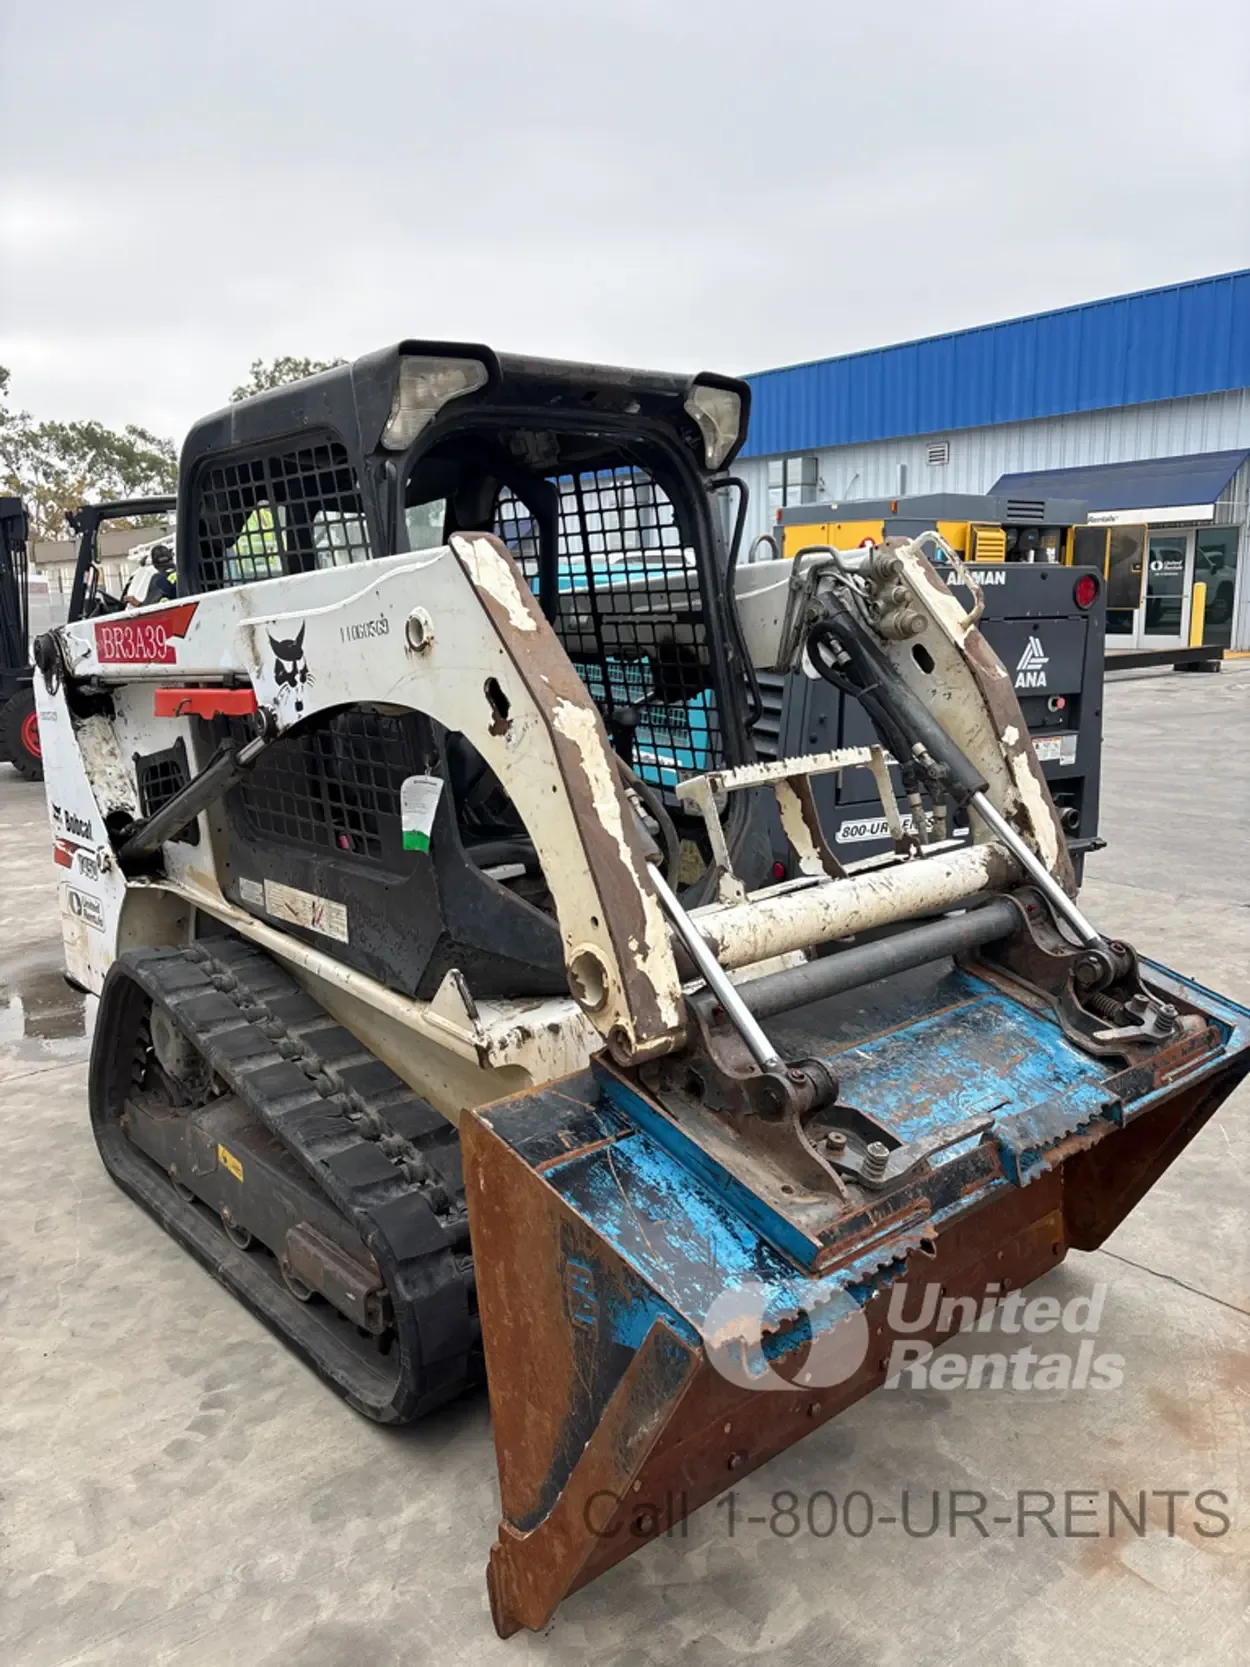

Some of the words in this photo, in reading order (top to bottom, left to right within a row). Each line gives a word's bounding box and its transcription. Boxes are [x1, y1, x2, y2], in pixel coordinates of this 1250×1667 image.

[946, 570, 1006, 586] AIMAN
[101, 625, 167, 659] BR3A39
[1014, 671, 1047, 688] ANA
[64, 809, 93, 841] Bobcat
